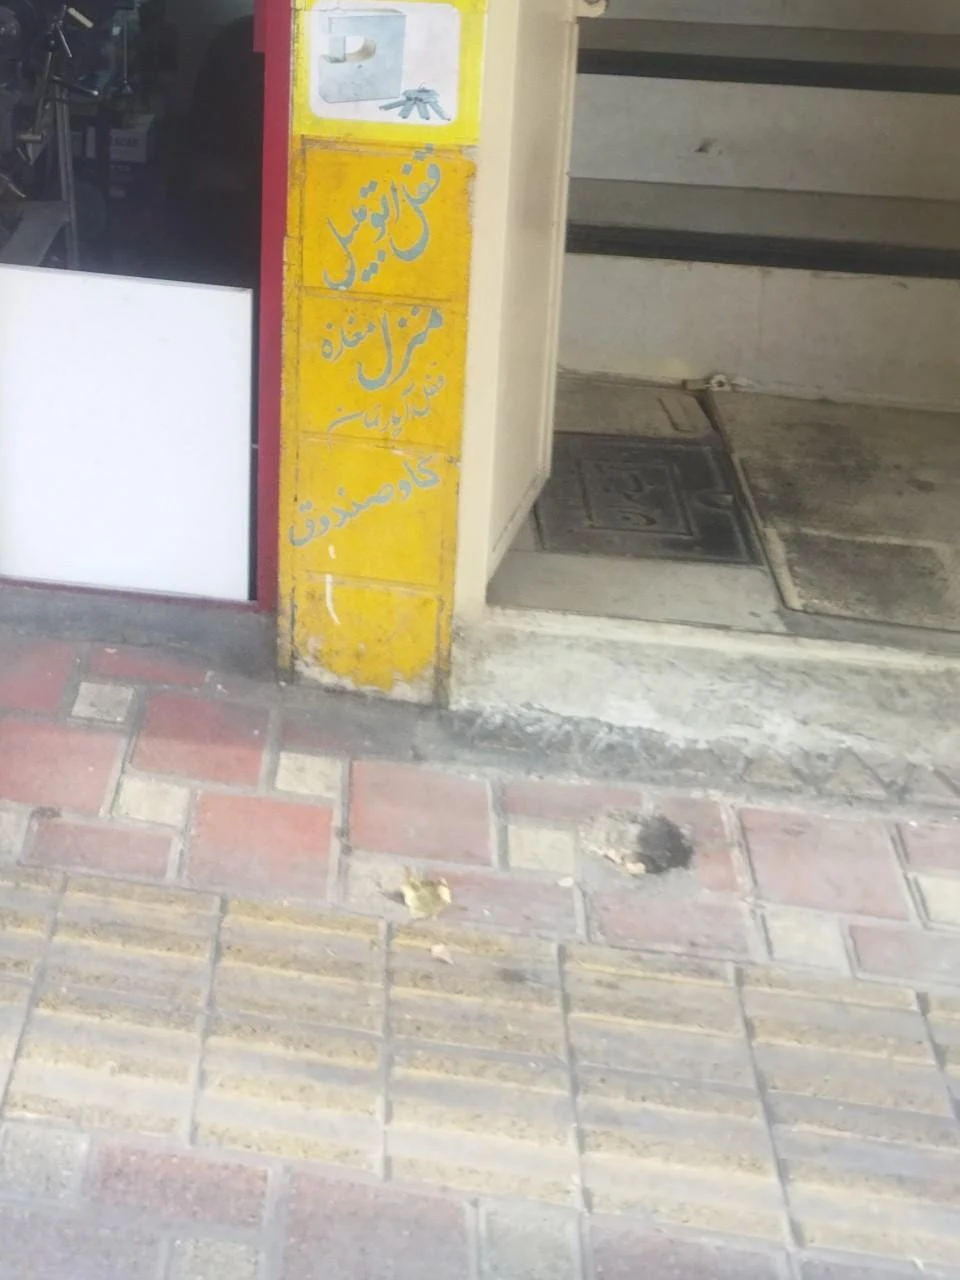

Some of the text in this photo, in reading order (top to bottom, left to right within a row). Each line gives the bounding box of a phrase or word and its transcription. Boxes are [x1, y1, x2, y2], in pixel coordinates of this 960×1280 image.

[323, 143, 442, 291] قفل اتومبیل
[321, 305, 444, 391] منزل مغازه
